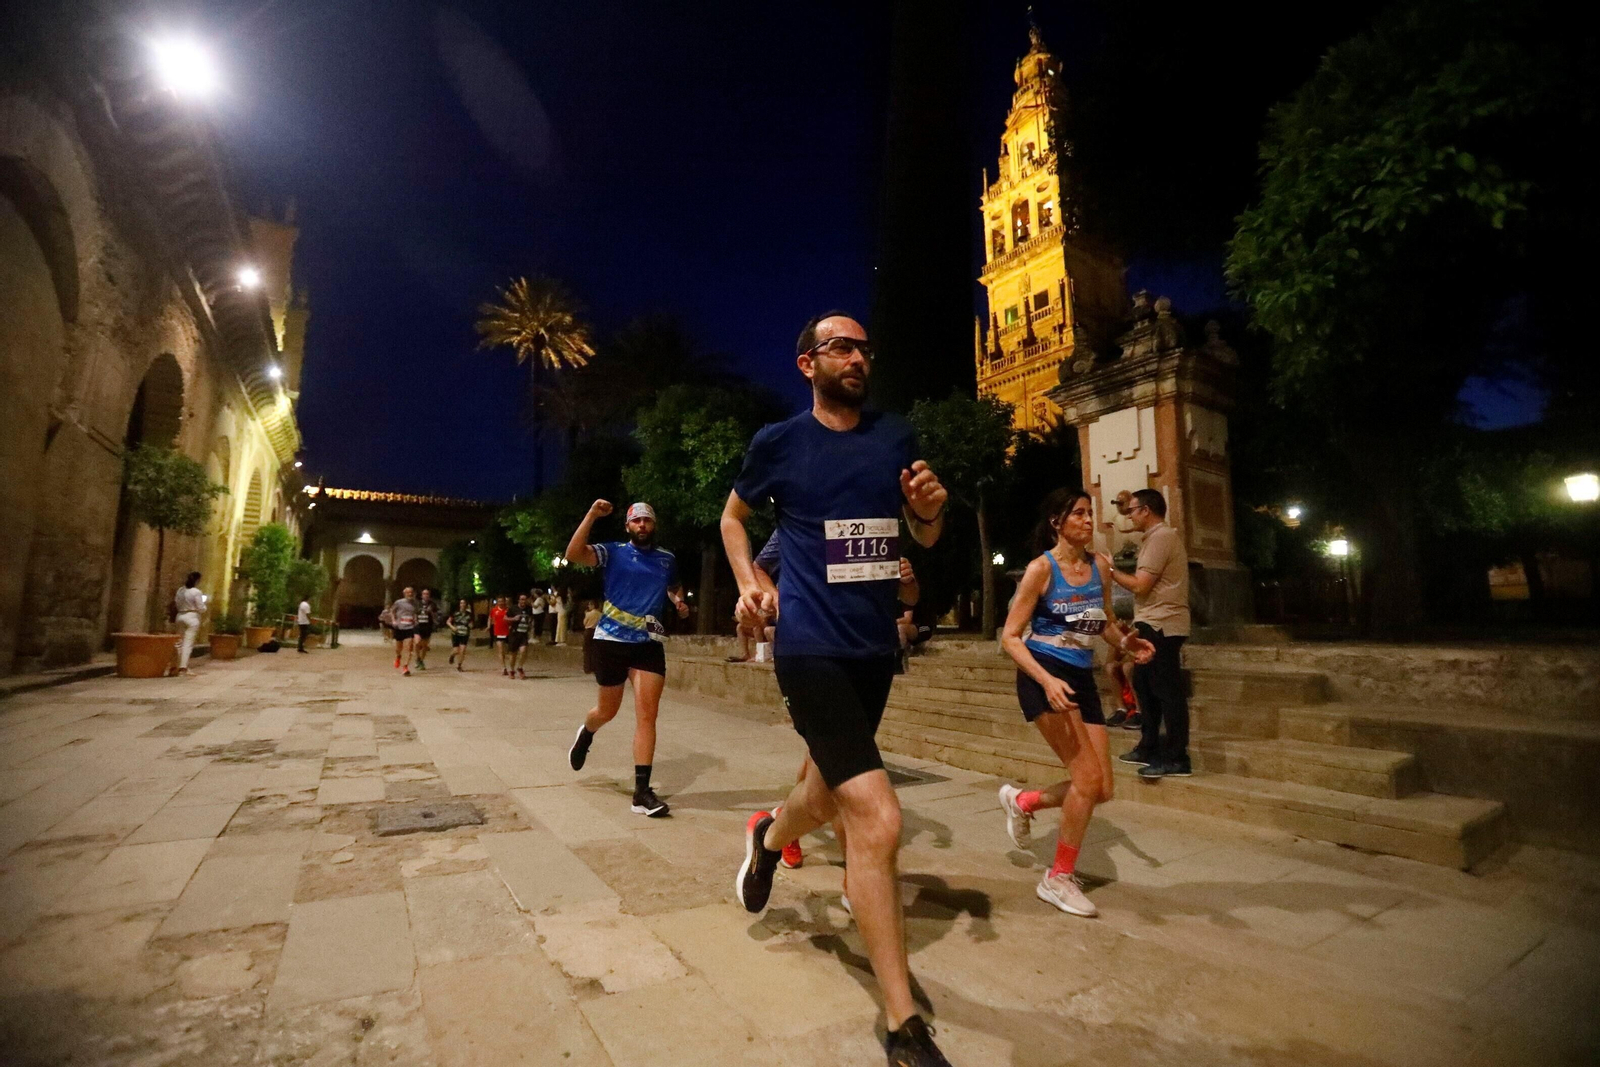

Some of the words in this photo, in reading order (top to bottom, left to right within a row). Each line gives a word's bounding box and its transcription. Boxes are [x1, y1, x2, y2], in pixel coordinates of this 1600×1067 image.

[850, 523, 865, 536] 20
[845, 538, 888, 557] 1116
[1052, 602, 1068, 614] 20
